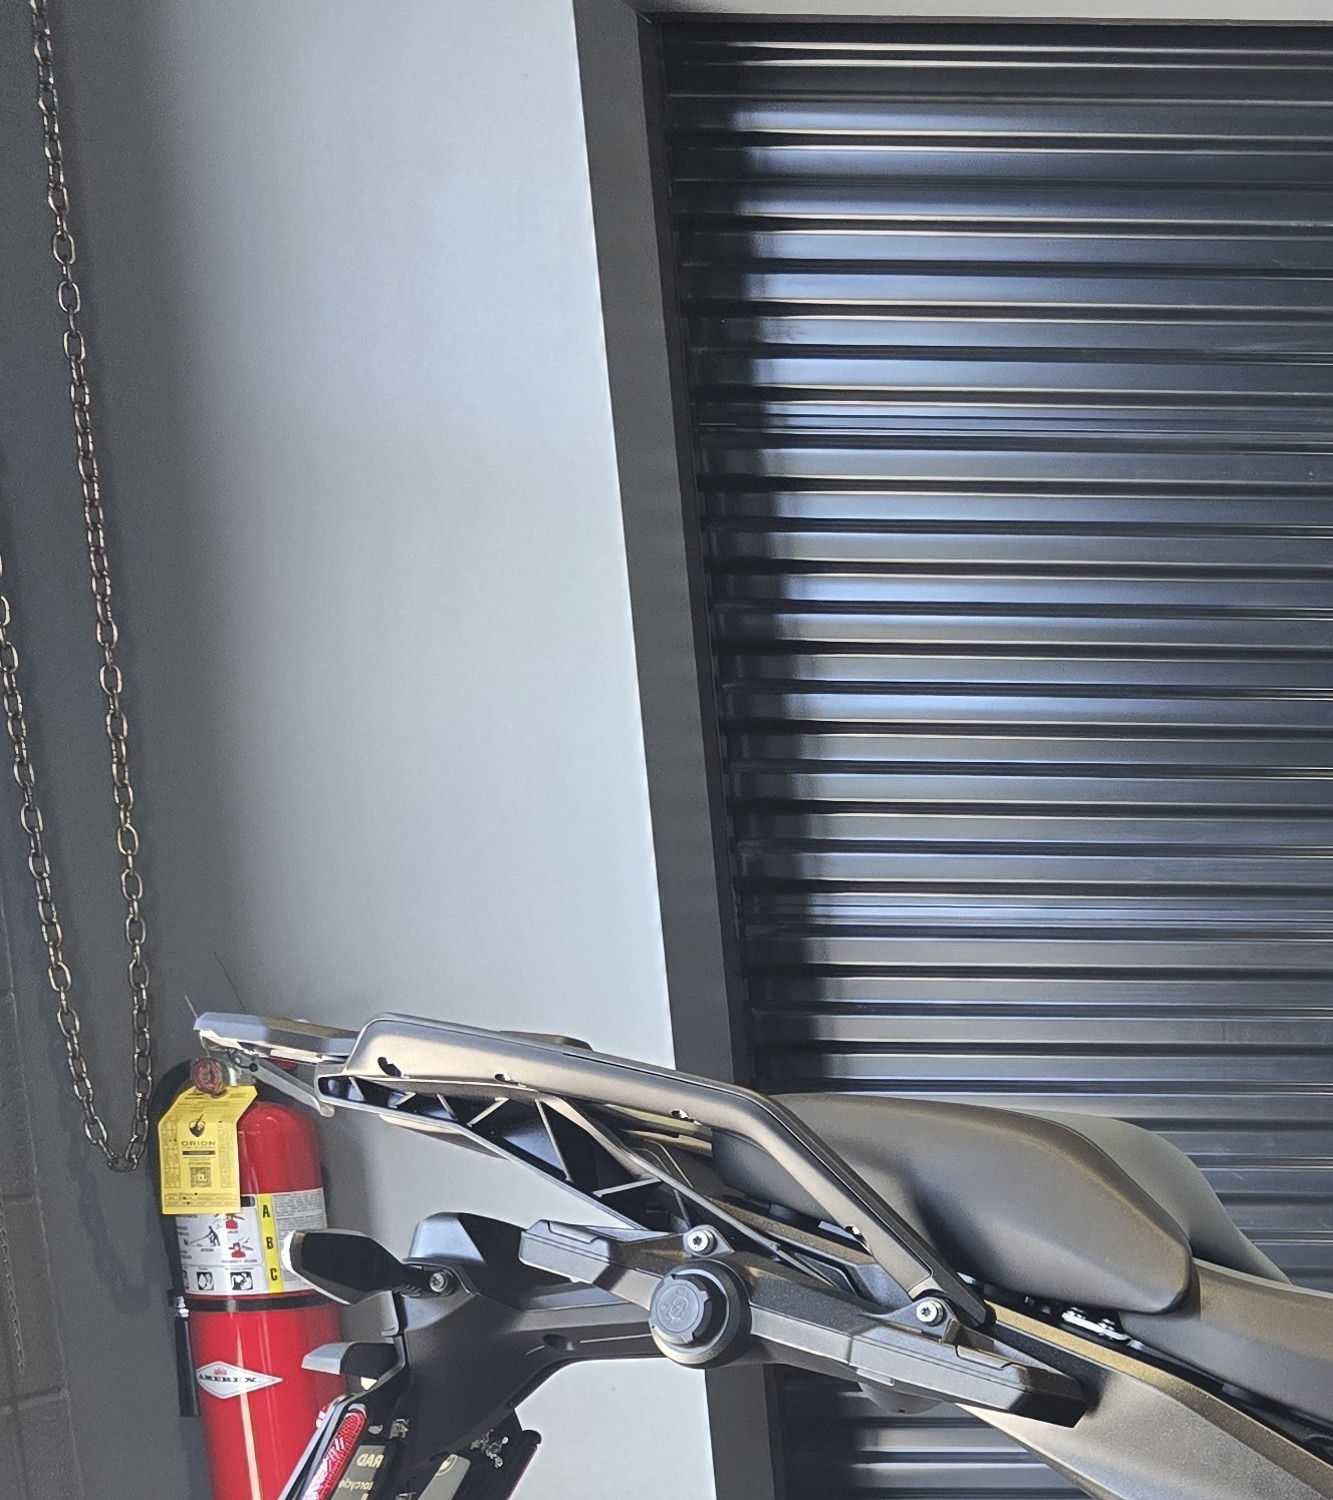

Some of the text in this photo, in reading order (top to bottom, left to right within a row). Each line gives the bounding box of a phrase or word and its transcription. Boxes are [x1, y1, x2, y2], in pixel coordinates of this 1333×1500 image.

[262, 1204, 271, 1218] A
[266, 1237, 274, 1249] B
[270, 1267, 278, 1281] C
